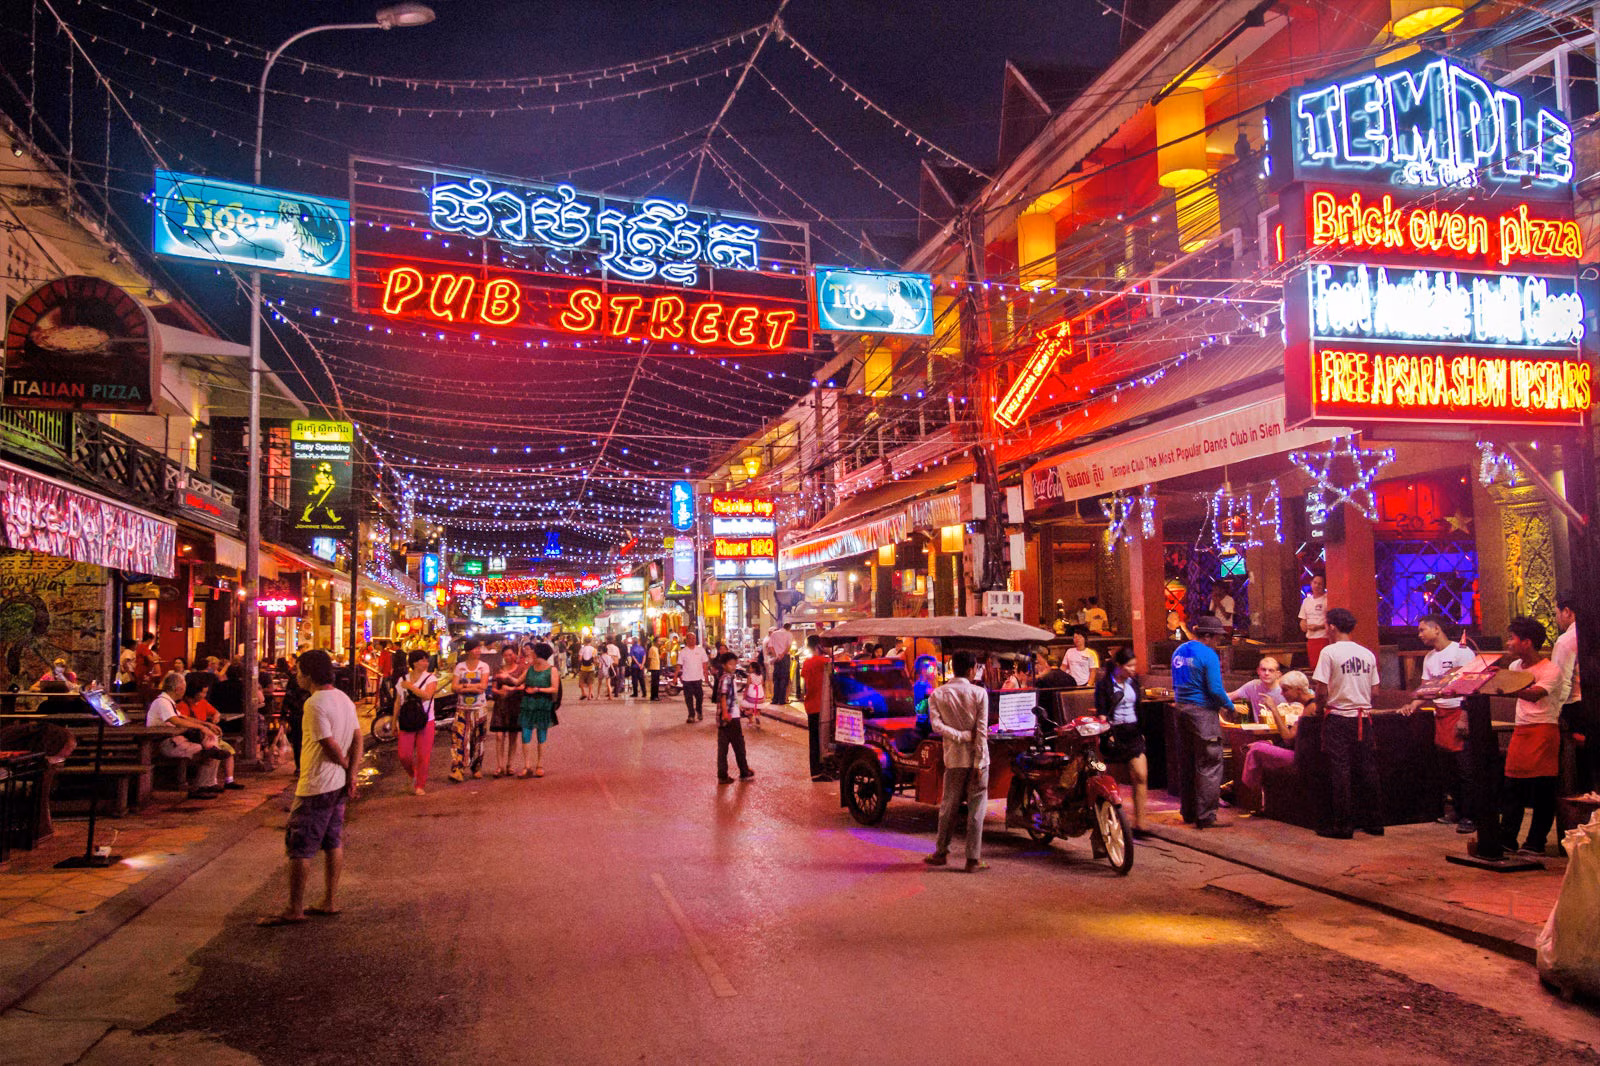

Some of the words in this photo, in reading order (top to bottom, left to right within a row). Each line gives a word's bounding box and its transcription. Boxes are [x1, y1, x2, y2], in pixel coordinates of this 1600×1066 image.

[1299, 59, 1573, 183] TEMPLE
[179, 196, 275, 247] Tiger
[1312, 192, 1403, 247] Brick
[1409, 210, 1489, 254] oven
[1500, 204, 1583, 265] pizza
[382, 267, 521, 325] PUB
[560, 289, 796, 349] STREET
[829, 284, 885, 320] Tiger
[1316, 264, 1371, 332] Food
[13, 380, 85, 397] ITALIAN
[92, 384, 141, 399] PIZZA
[1320, 350, 1369, 403] FREE
[1371, 355, 1449, 405] APSARA
[1450, 356, 1507, 408] SHOW
[1510, 360, 1591, 410] UPSTAIRS
[294, 442, 314, 452] Easy
[315, 443, 350, 453] Speaking
[1110, 465, 1130, 478] Temple
[1131, 459, 1144, 473] Club
[1145, 456, 1156, 468] The
[1158, 451, 1174, 465] Most
[1176, 443, 1201, 461] Popular
[1203, 437, 1227, 454] Dance
[1230, 430, 1248, 446] Club
[1249, 427, 1258, 442] in
[1260, 422, 1280, 439] Siem
[715, 539, 748, 556] Khmer
[751, 539, 774, 556] BBQ
[1340, 656, 1371, 674] TEMPLE
